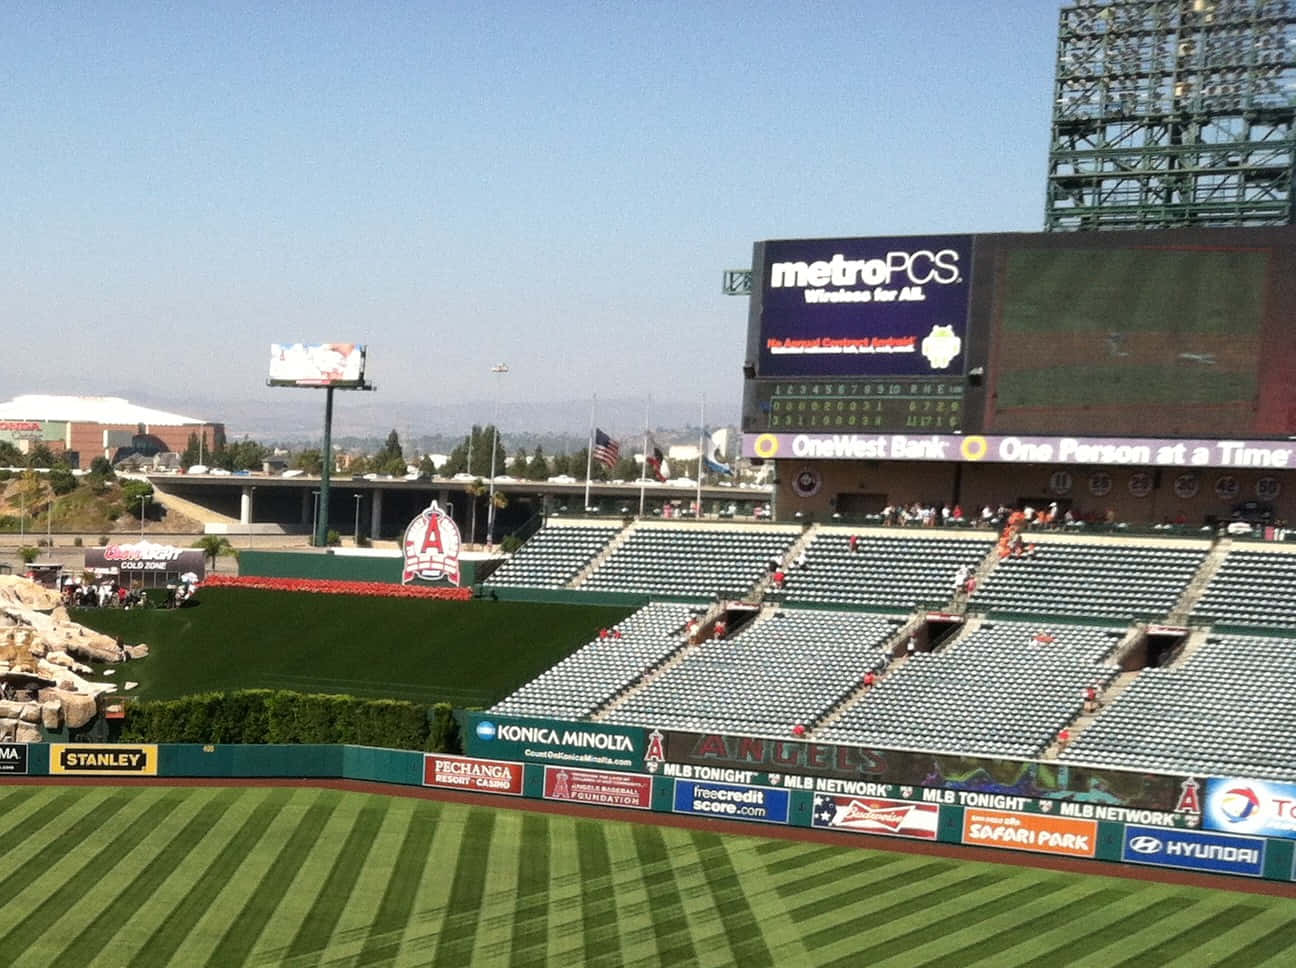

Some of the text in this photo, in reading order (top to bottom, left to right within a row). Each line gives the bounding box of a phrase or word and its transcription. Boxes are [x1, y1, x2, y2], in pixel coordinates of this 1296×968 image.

[771, 250, 960, 287] metroPCS
[874, 288, 898, 301] for
[792, 436, 947, 459] OneWest Bank
[999, 437, 1289, 467] One Person at a Time
[121, 561, 167, 571] COLD ZONE
[497, 724, 634, 752] KONICA MINOLTA
[66, 752, 141, 767] STANLEY
[689, 734, 889, 774] ANGELS
[435, 760, 512, 781] PECHANGA
[664, 763, 753, 784] MLB TONIGHT
[435, 774, 511, 791] RESORT CASINO
[784, 775, 888, 796] MLB NETWORK
[570, 791, 640, 807] FOUNDATION
[693, 785, 764, 805] freecredit
[923, 789, 1026, 811] MLB TONIGHT
[693, 798, 766, 817] score.com
[1060, 803, 1175, 826] MLB NETWORK
[969, 824, 1089, 850] SAFARI PARK
[1166, 841, 1258, 865] HYUNDAI
